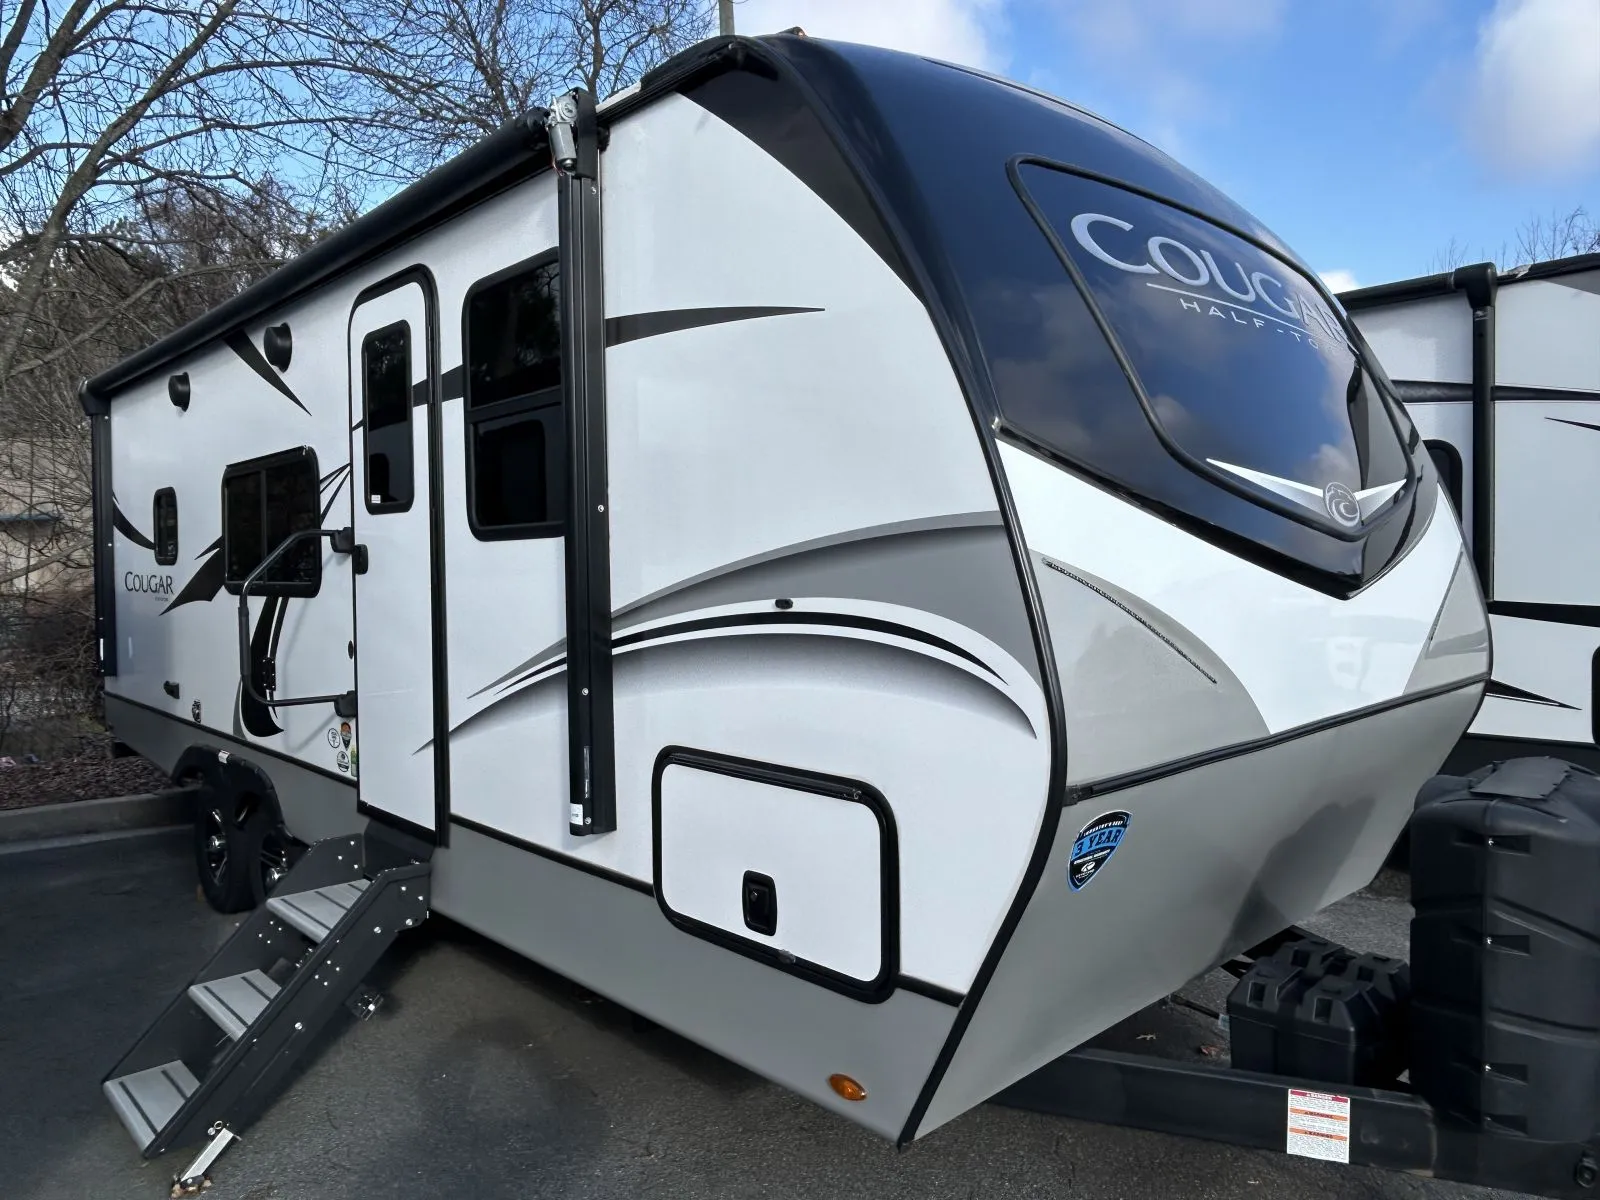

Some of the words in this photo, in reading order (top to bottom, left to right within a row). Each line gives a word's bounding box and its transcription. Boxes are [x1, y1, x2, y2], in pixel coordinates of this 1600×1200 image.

[1070, 213, 1359, 355] COUGAR
[124, 571, 174, 595] COUGAR
[1075, 841, 1084, 856] 3
[1088, 829, 1122, 849] YEAR
